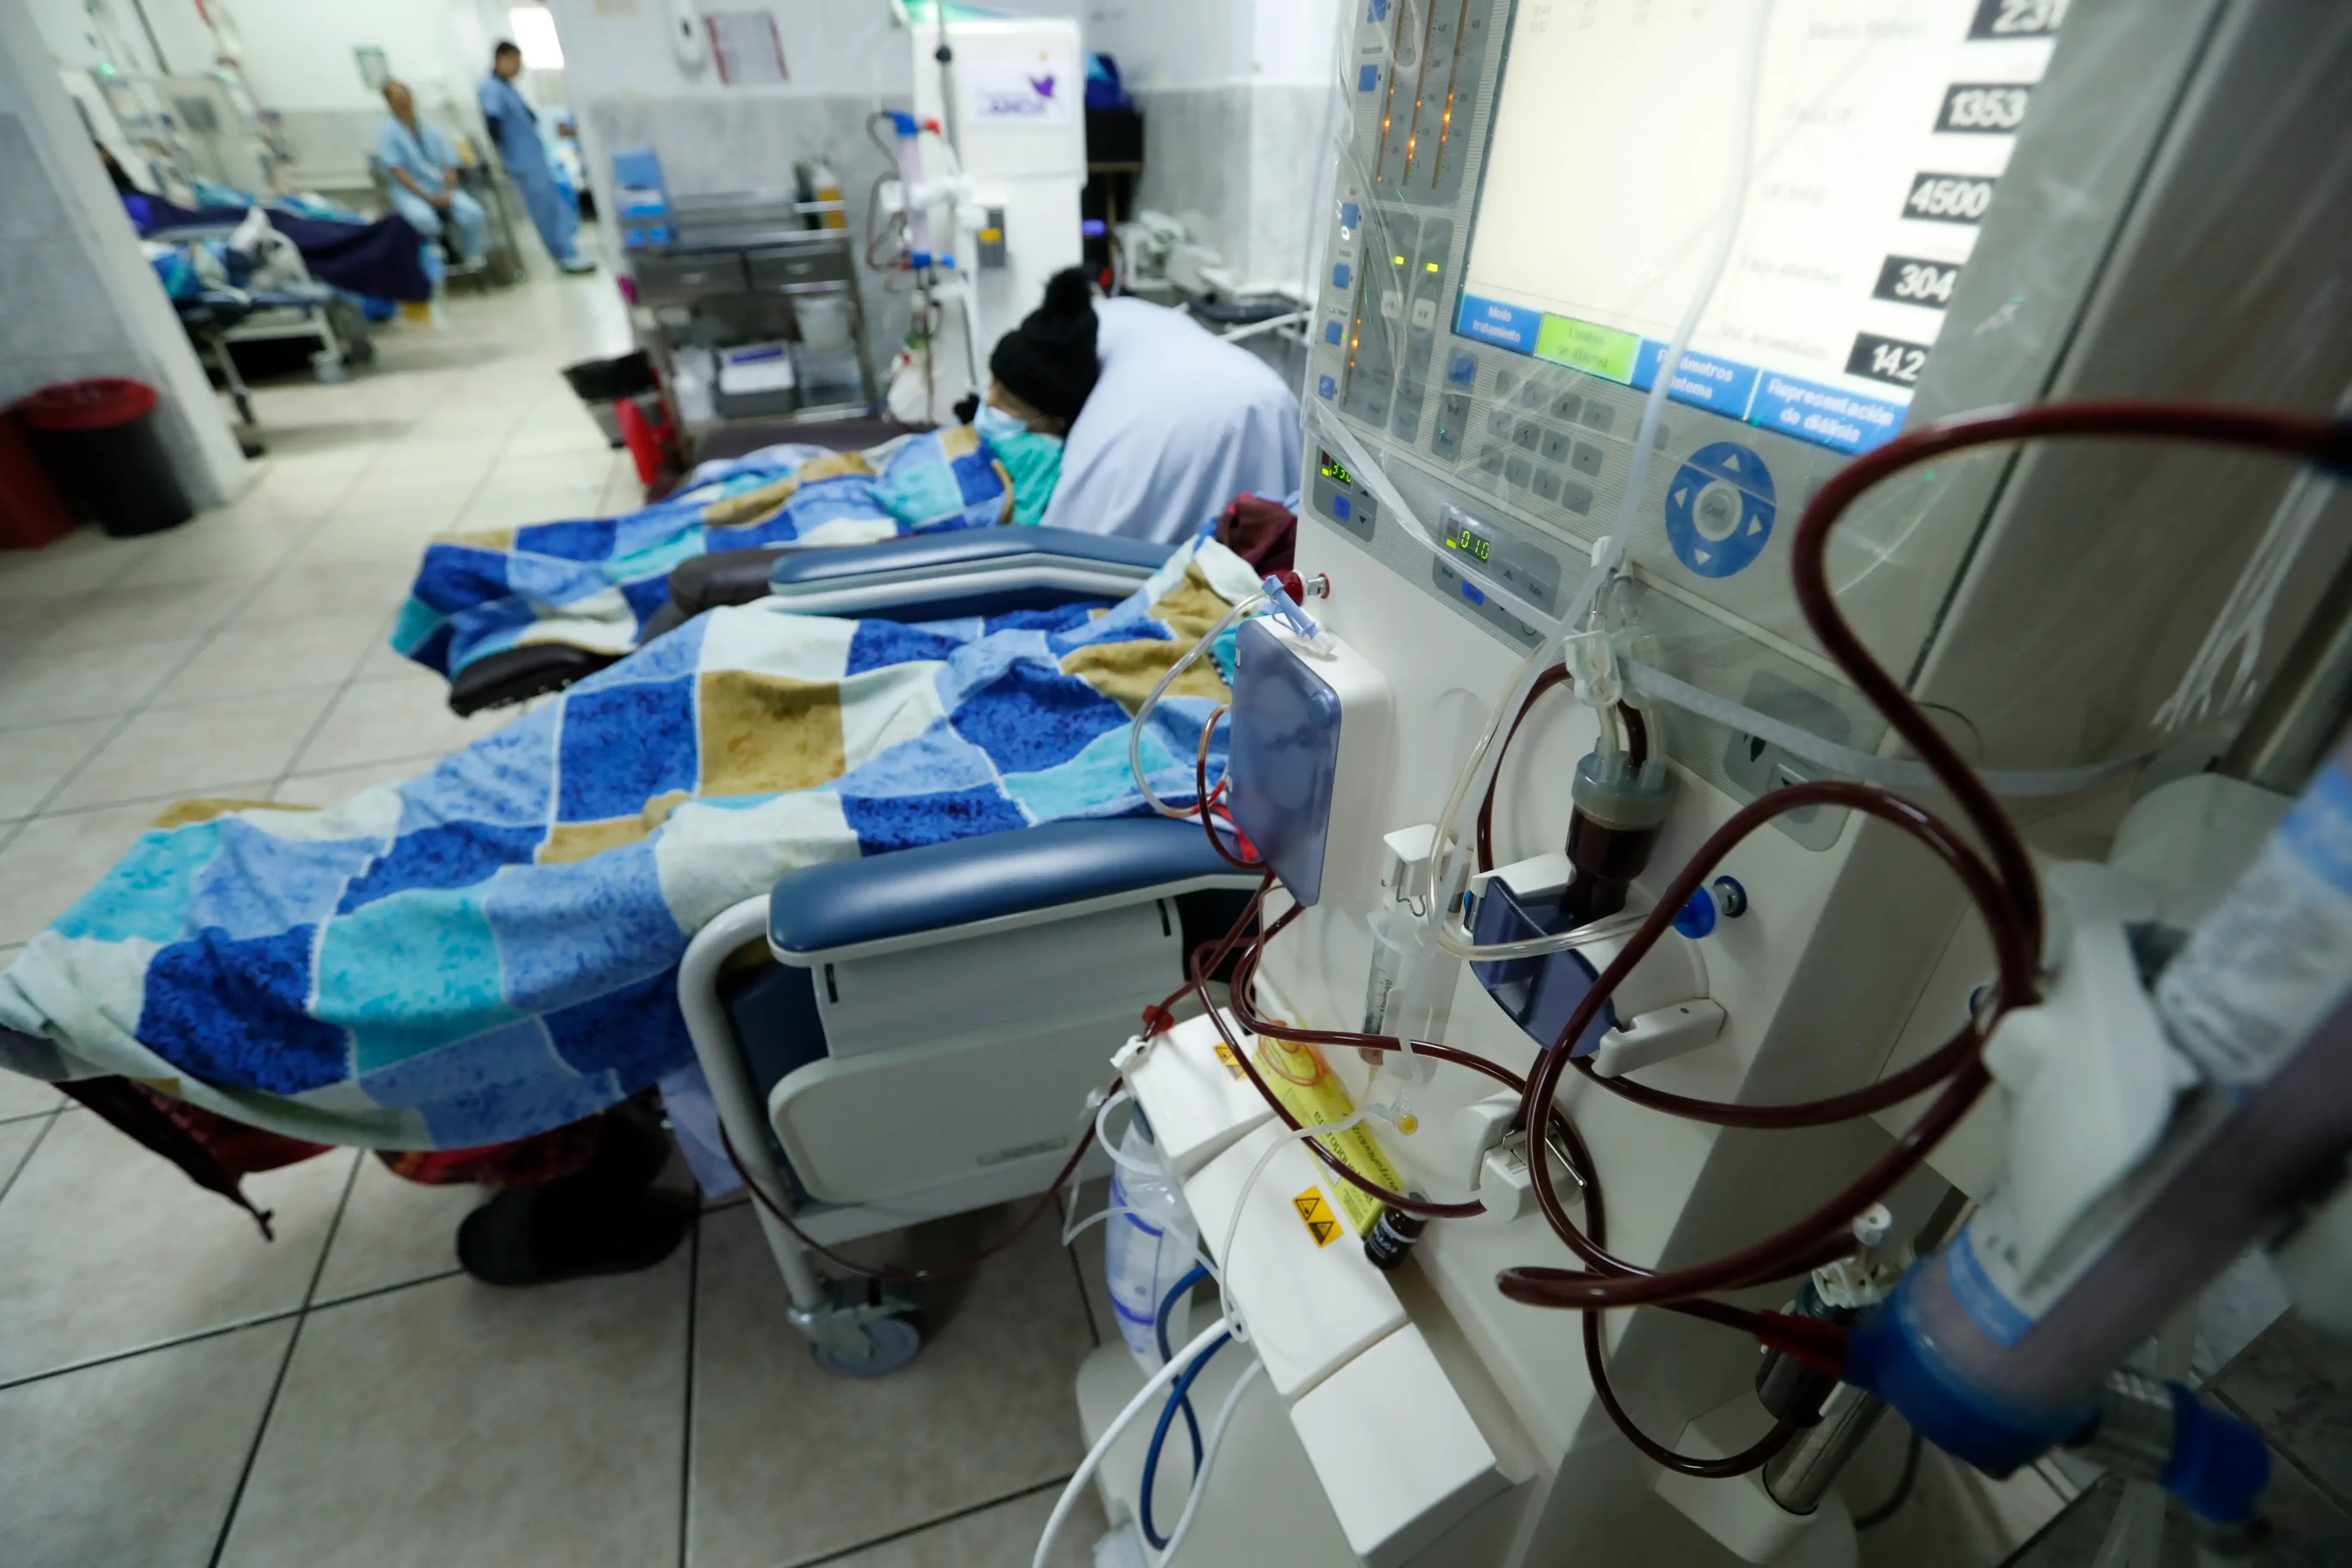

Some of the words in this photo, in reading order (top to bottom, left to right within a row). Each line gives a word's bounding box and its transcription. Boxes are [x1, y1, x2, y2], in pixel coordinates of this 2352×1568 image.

[1948, 88, 2029, 127] 1353
[1910, 179, 1992, 219] 4500
[1894, 263, 1957, 303] 304
[1473, 319, 1521, 343] tratamiento
[1488, 305, 1512, 322] Modo
